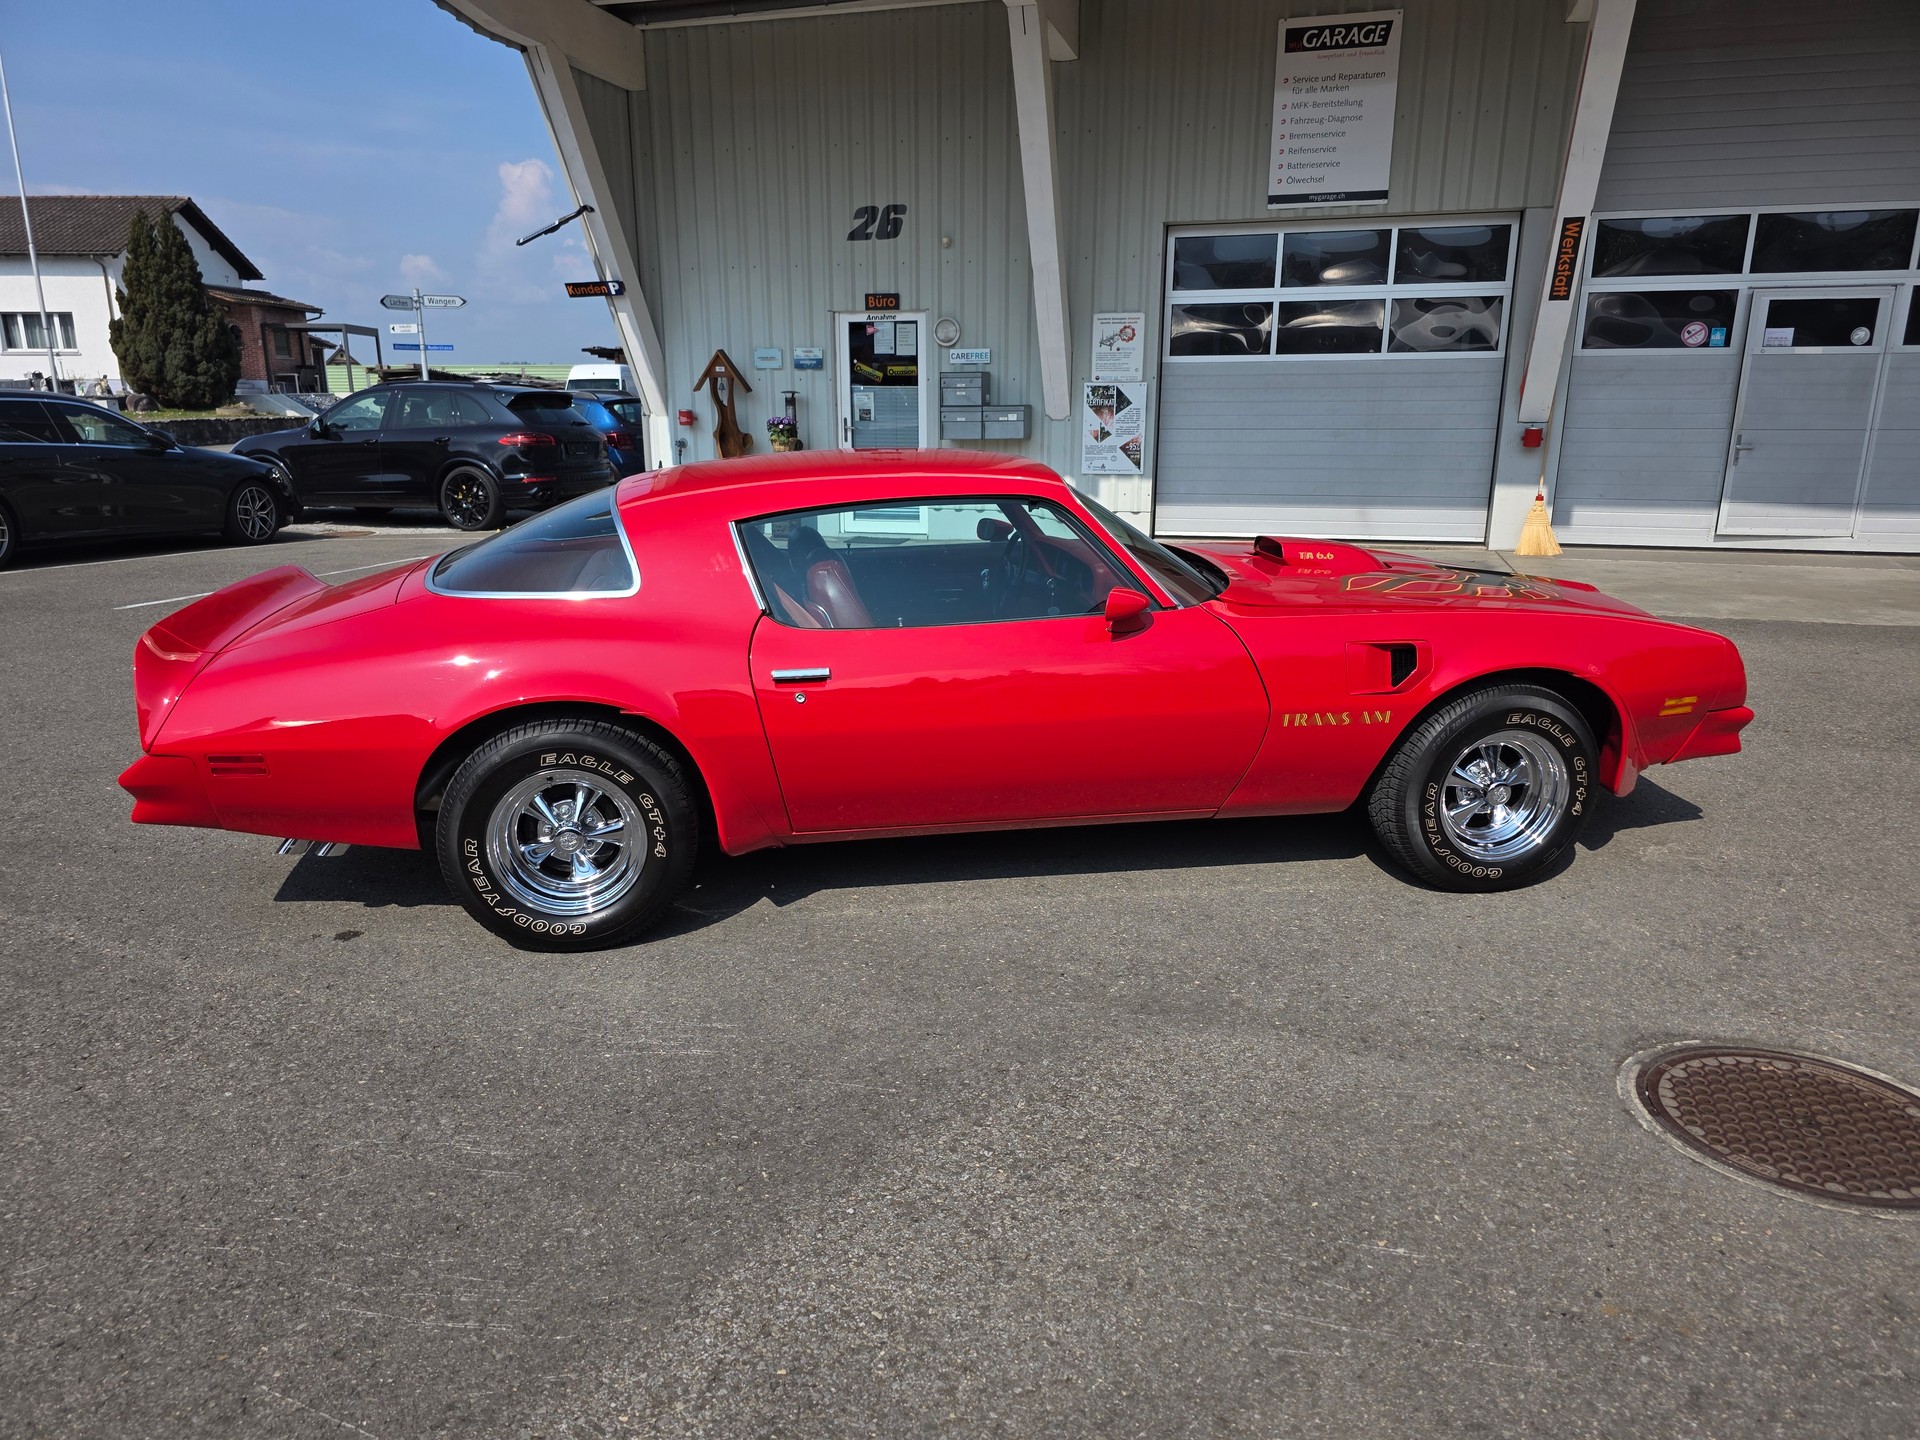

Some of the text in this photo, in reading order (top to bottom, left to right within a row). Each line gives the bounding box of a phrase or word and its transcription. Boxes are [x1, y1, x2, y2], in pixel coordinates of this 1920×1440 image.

[1302, 24, 1387, 48] GARAGE
[1292, 71, 1386, 84] Service und Reparaturen
[1292, 84, 1350, 95] für alle Marken
[1291, 99, 1363, 110] MFK-Bereitstellung
[1290, 114, 1363, 125] Fahrzeug-Diagnose
[1289, 130, 1346, 140] Bremsenservice
[1288, 145, 1337, 155] Reifenservice
[1287, 160, 1341, 170] Batterieservice
[1286, 174, 1325, 185] Ölwechsel
[1308, 193, 1346, 201] mygarage.ch
[847, 204, 907, 241] 26
[1553, 222, 1581, 296] Werkstatt
[567, 282, 620, 295] Kunden P
[389, 298, 409, 307] Lachen
[427, 297, 456, 307] Wangen
[868, 295, 896, 308] Büro
[866, 313, 897, 321] Annahme
[950, 352, 990, 360] CAREFREE
[855, 363, 881, 380] Occasion
[888, 368, 916, 376] Occasion
[1316, 552, 1334, 560] 6.6
[1282, 710, 1391, 727] TRANS AM
[1506, 713, 1588, 816] EAGLE GT+4
[540, 753, 635, 785] EAGLE
[639, 792, 667, 858] GT+4
[1424, 783, 1503, 878] GOODYEAR
[464, 838, 587, 935] GOODYEAR
